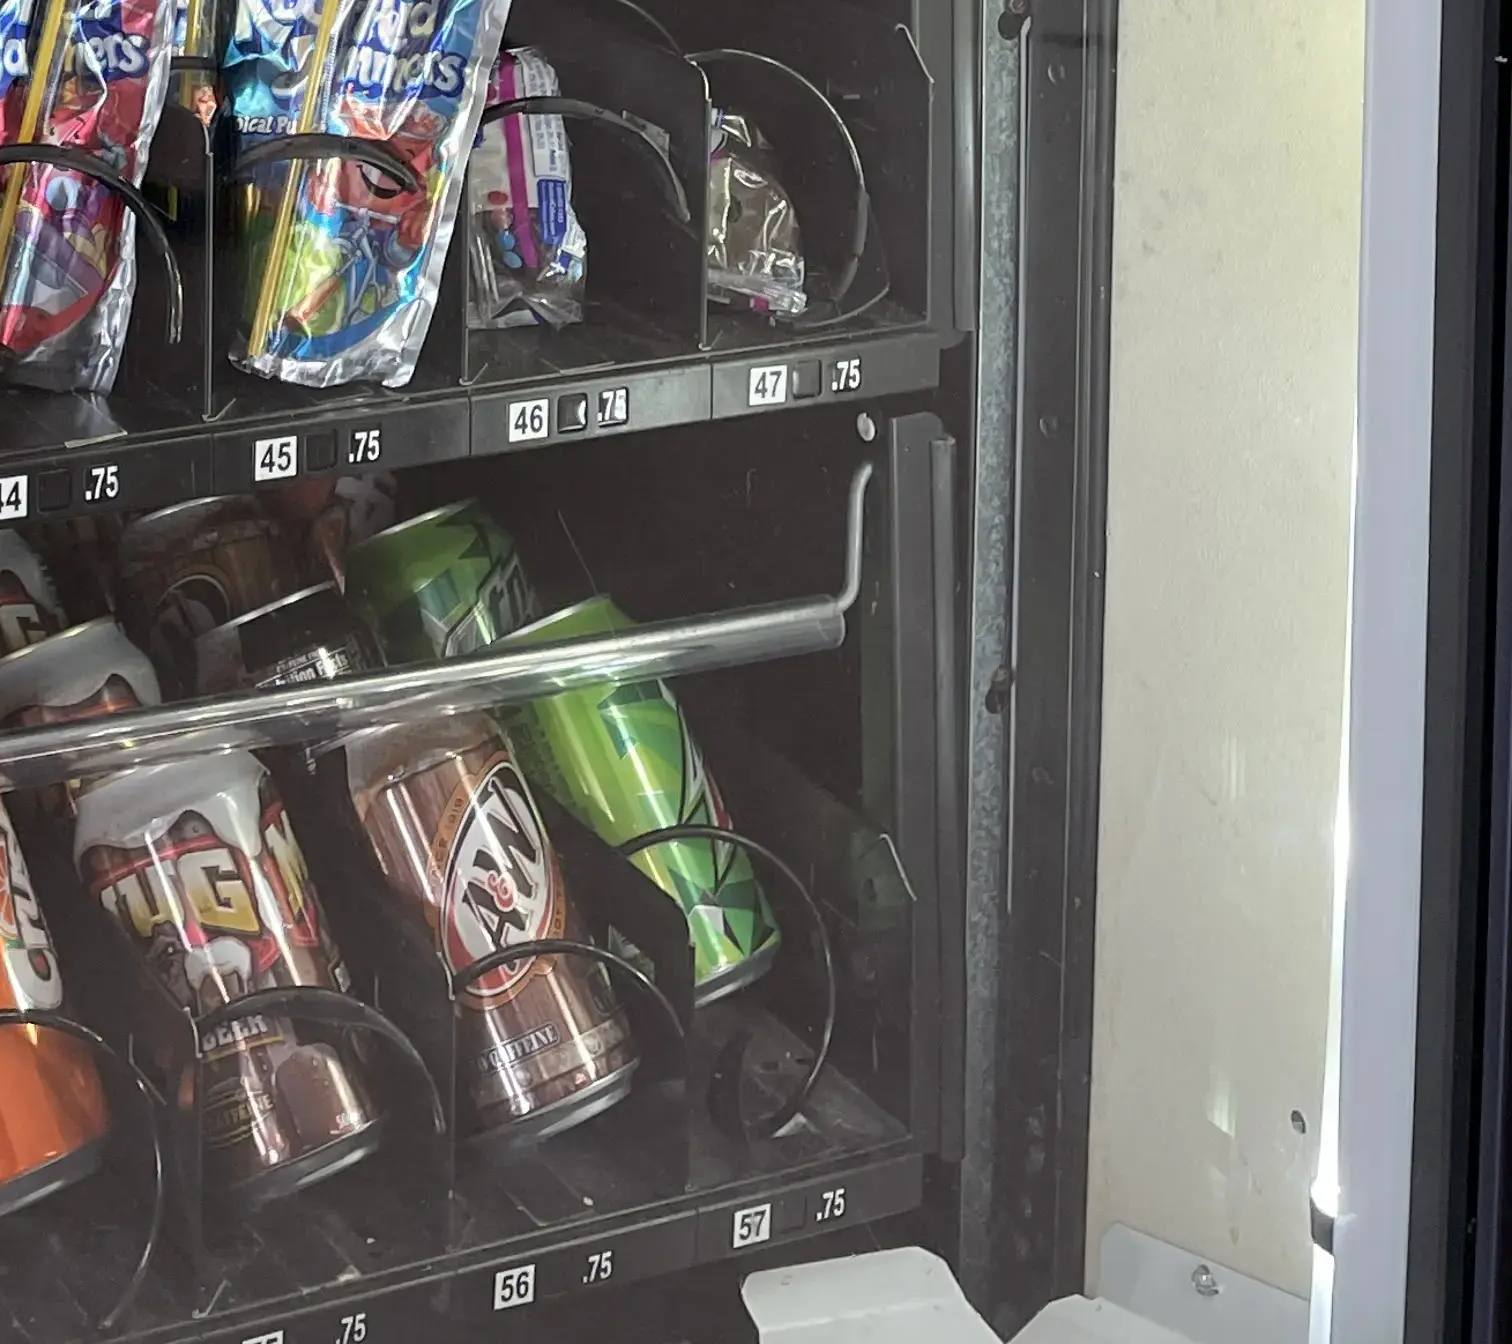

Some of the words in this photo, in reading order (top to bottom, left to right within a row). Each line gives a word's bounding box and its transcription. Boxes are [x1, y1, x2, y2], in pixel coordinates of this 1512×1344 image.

[755, 372, 782, 400] 47
[832, 362, 860, 391] .75
[514, 405, 543, 433] 46
[597, 390, 626, 420] .75
[260, 445, 291, 472] 45
[348, 431, 380, 462] .75
[85, 467, 120, 500] .75
[463, 776, 539, 973] A&W
[817, 1190, 845, 1220] .75
[738, 1214, 767, 1238] 57
[583, 1252, 612, 1283] .75
[502, 1274, 529, 1298] 56
